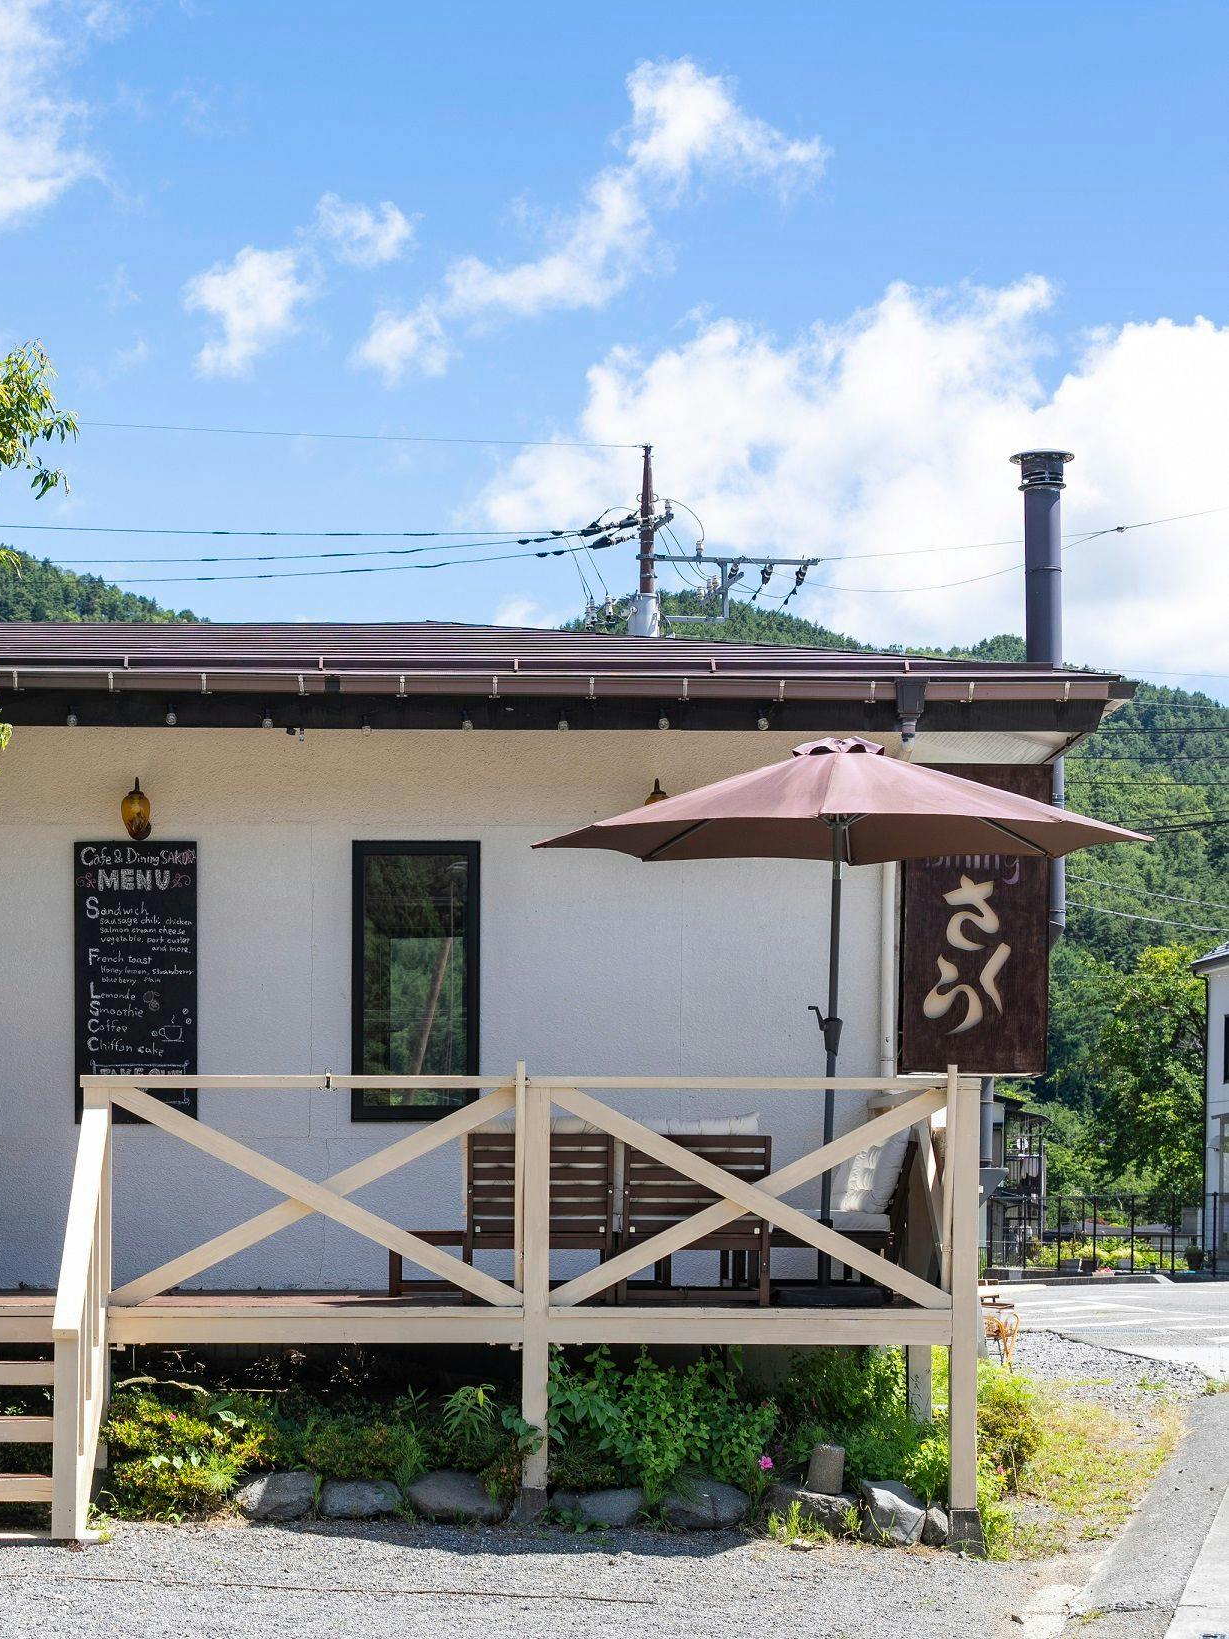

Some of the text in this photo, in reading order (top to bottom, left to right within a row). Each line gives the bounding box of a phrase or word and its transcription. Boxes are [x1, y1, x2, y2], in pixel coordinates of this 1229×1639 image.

[80, 847, 111, 866] Cafe
[114, 849, 123, 863] &
[125, 847, 159, 866] Dining
[97, 869, 170, 891] MENU
[85, 896, 149, 919] Sandwich
[89, 948, 124, 965] French
[923, 874, 1012, 1035] さくら
[89, 1000, 144, 1017] Smoothie
[87, 1018, 128, 1033] Coffee
[87, 1037, 164, 1056] Chiffon cake
